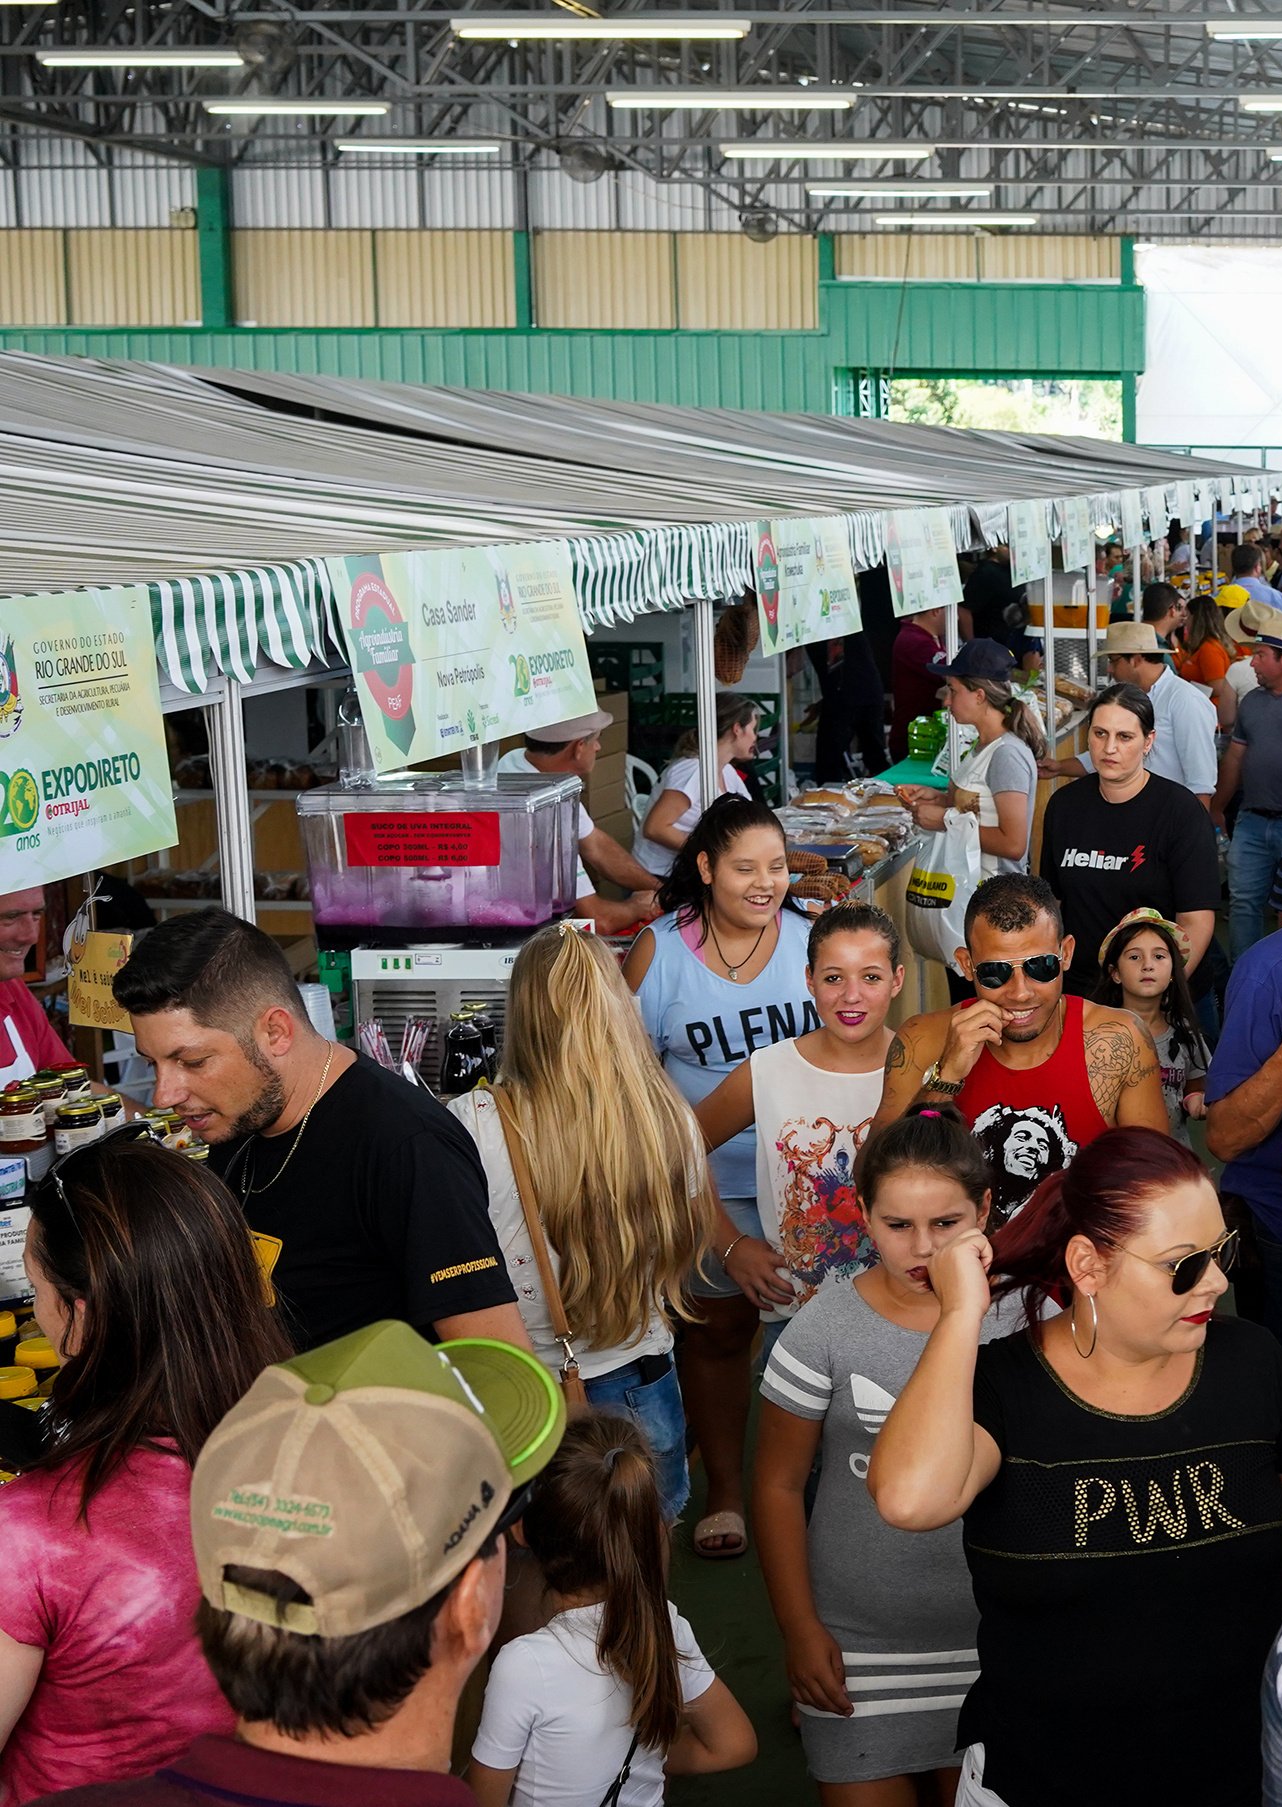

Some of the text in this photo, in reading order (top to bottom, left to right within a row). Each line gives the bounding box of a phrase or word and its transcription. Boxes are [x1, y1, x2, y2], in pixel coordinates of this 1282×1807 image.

[422, 599, 477, 627] Casa Sander
[33, 631, 125, 655] GOVERNO DO ESTADO
[35, 650, 128, 680] RIO GRANDE DO SUL
[529, 649, 575, 675] EXPODIRETO
[437, 663, 485, 690] Nova Petrópolis
[41, 751, 140, 801] EXPODIRETO
[16, 832, 40, 852] anos
[1060, 848, 1128, 870] Heliar
[80, 969, 91, 983] Mel
[71, 980, 91, 1018] Mel
[1074, 1461, 1246, 1547] PWR
